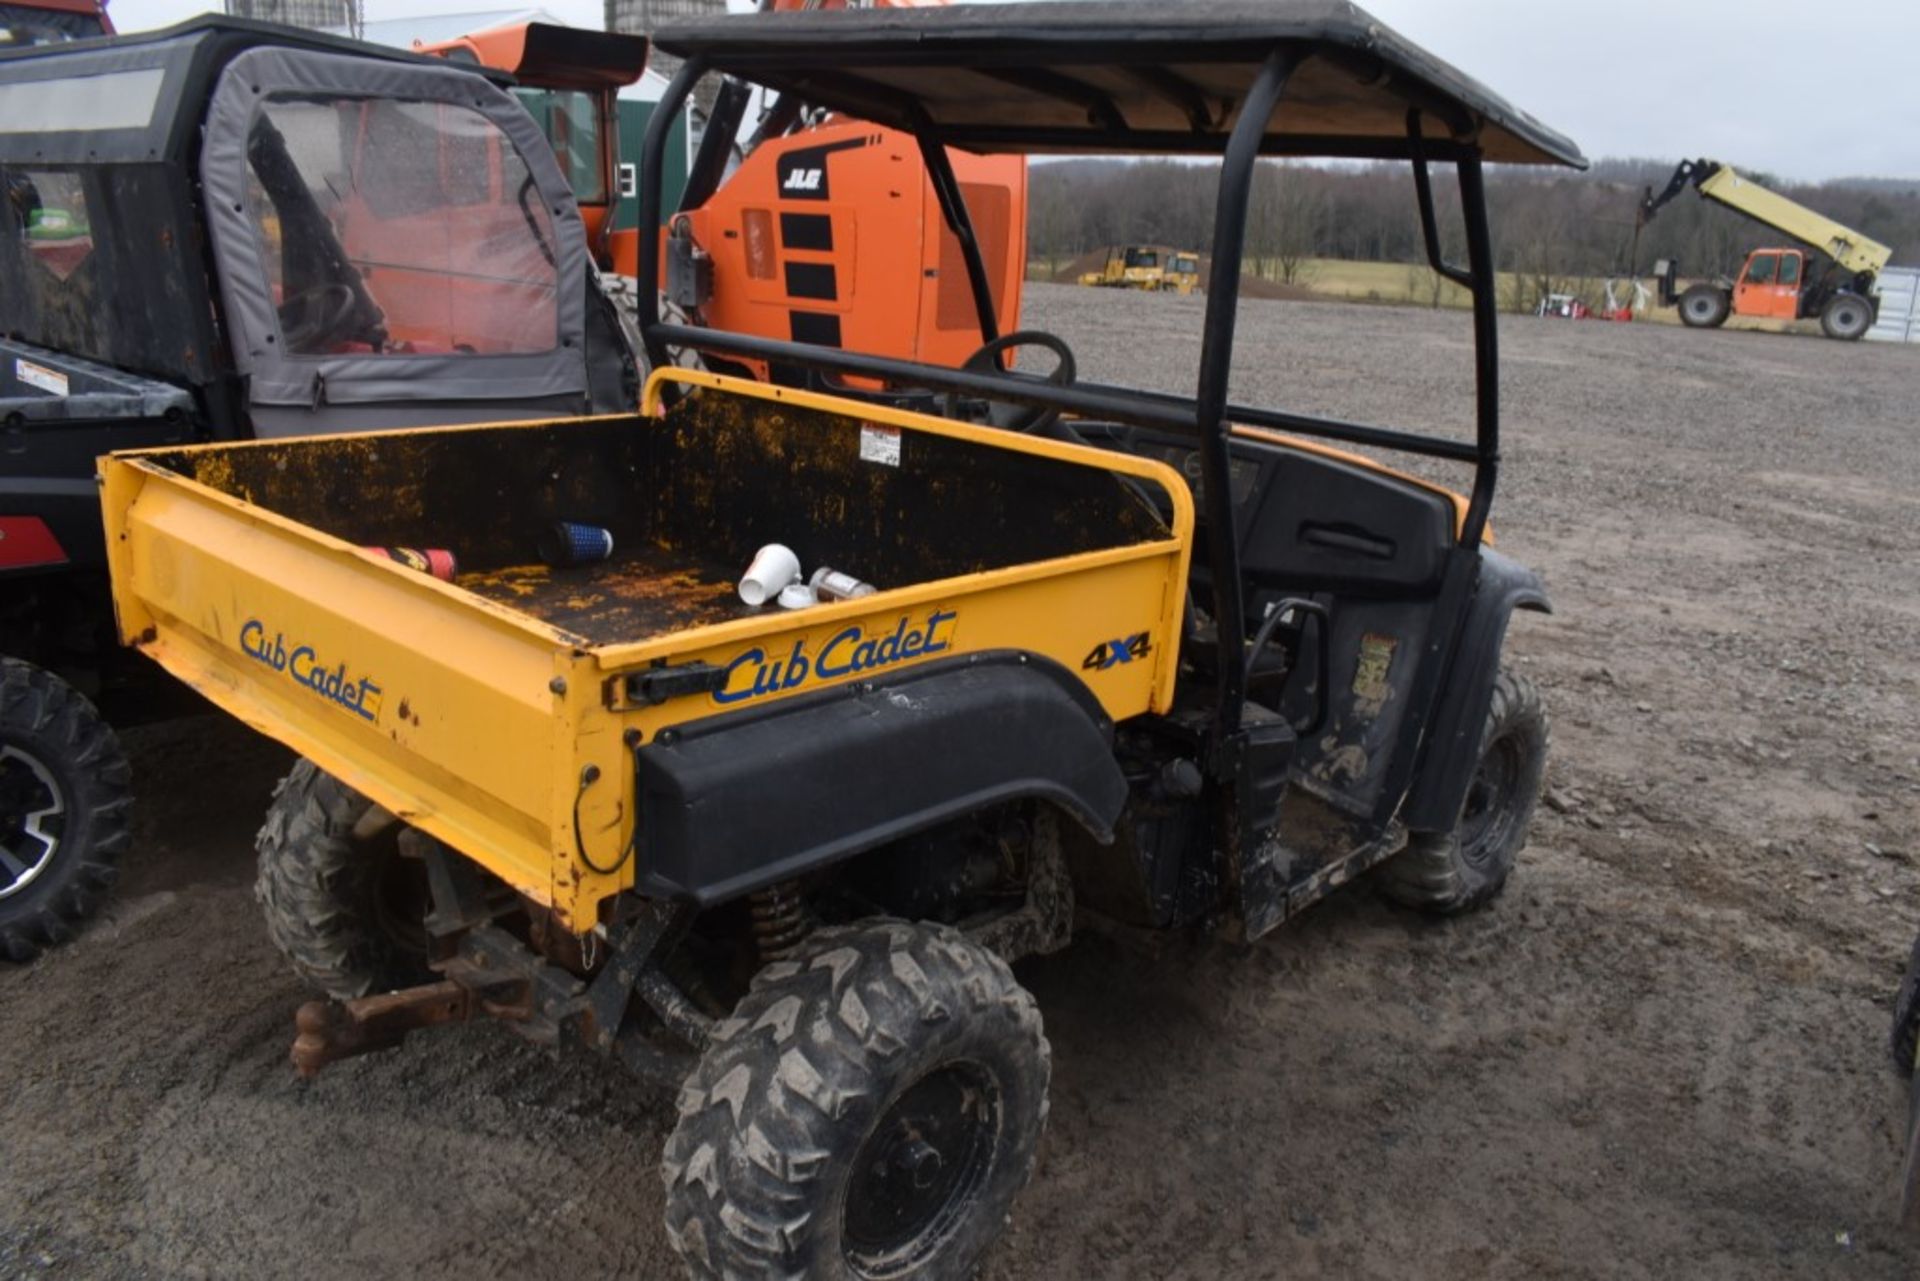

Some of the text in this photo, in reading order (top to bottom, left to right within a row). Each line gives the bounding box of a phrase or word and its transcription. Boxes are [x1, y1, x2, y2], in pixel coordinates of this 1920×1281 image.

[783, 168, 821, 189] JLG
[240, 620, 381, 721] Cub Cadet
[712, 611, 957, 704] Cub Cadet
